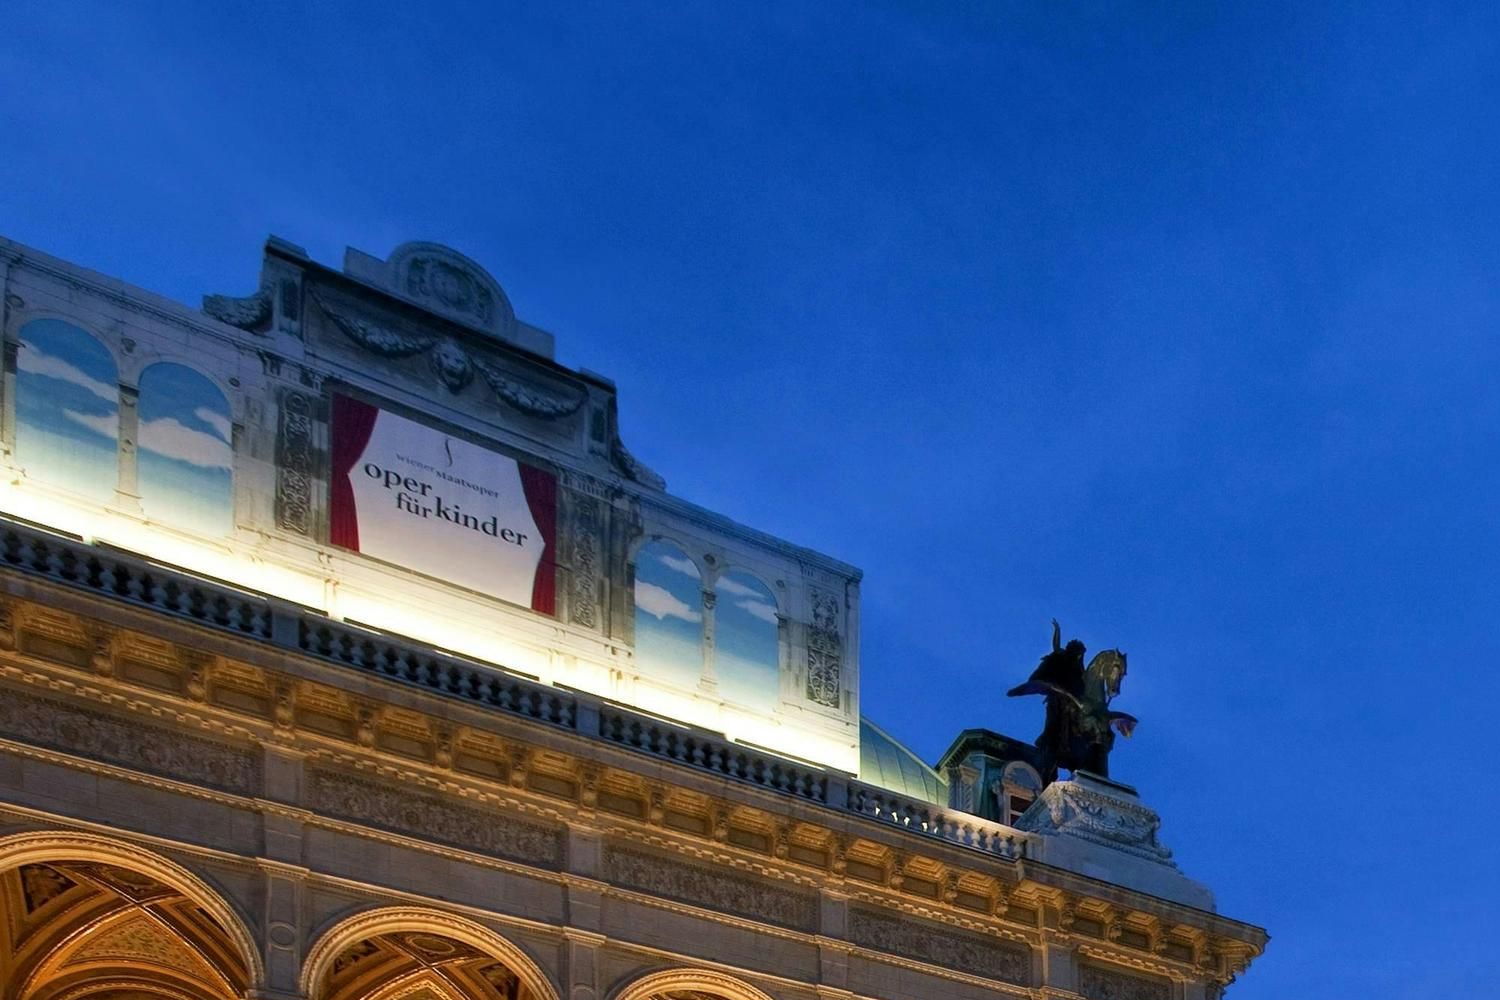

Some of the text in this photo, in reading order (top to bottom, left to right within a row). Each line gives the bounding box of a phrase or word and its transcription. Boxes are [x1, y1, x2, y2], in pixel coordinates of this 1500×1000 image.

[364, 462, 433, 497] oper
[436, 470, 499, 499] staatsoper
[397, 492, 528, 547] für kinder
